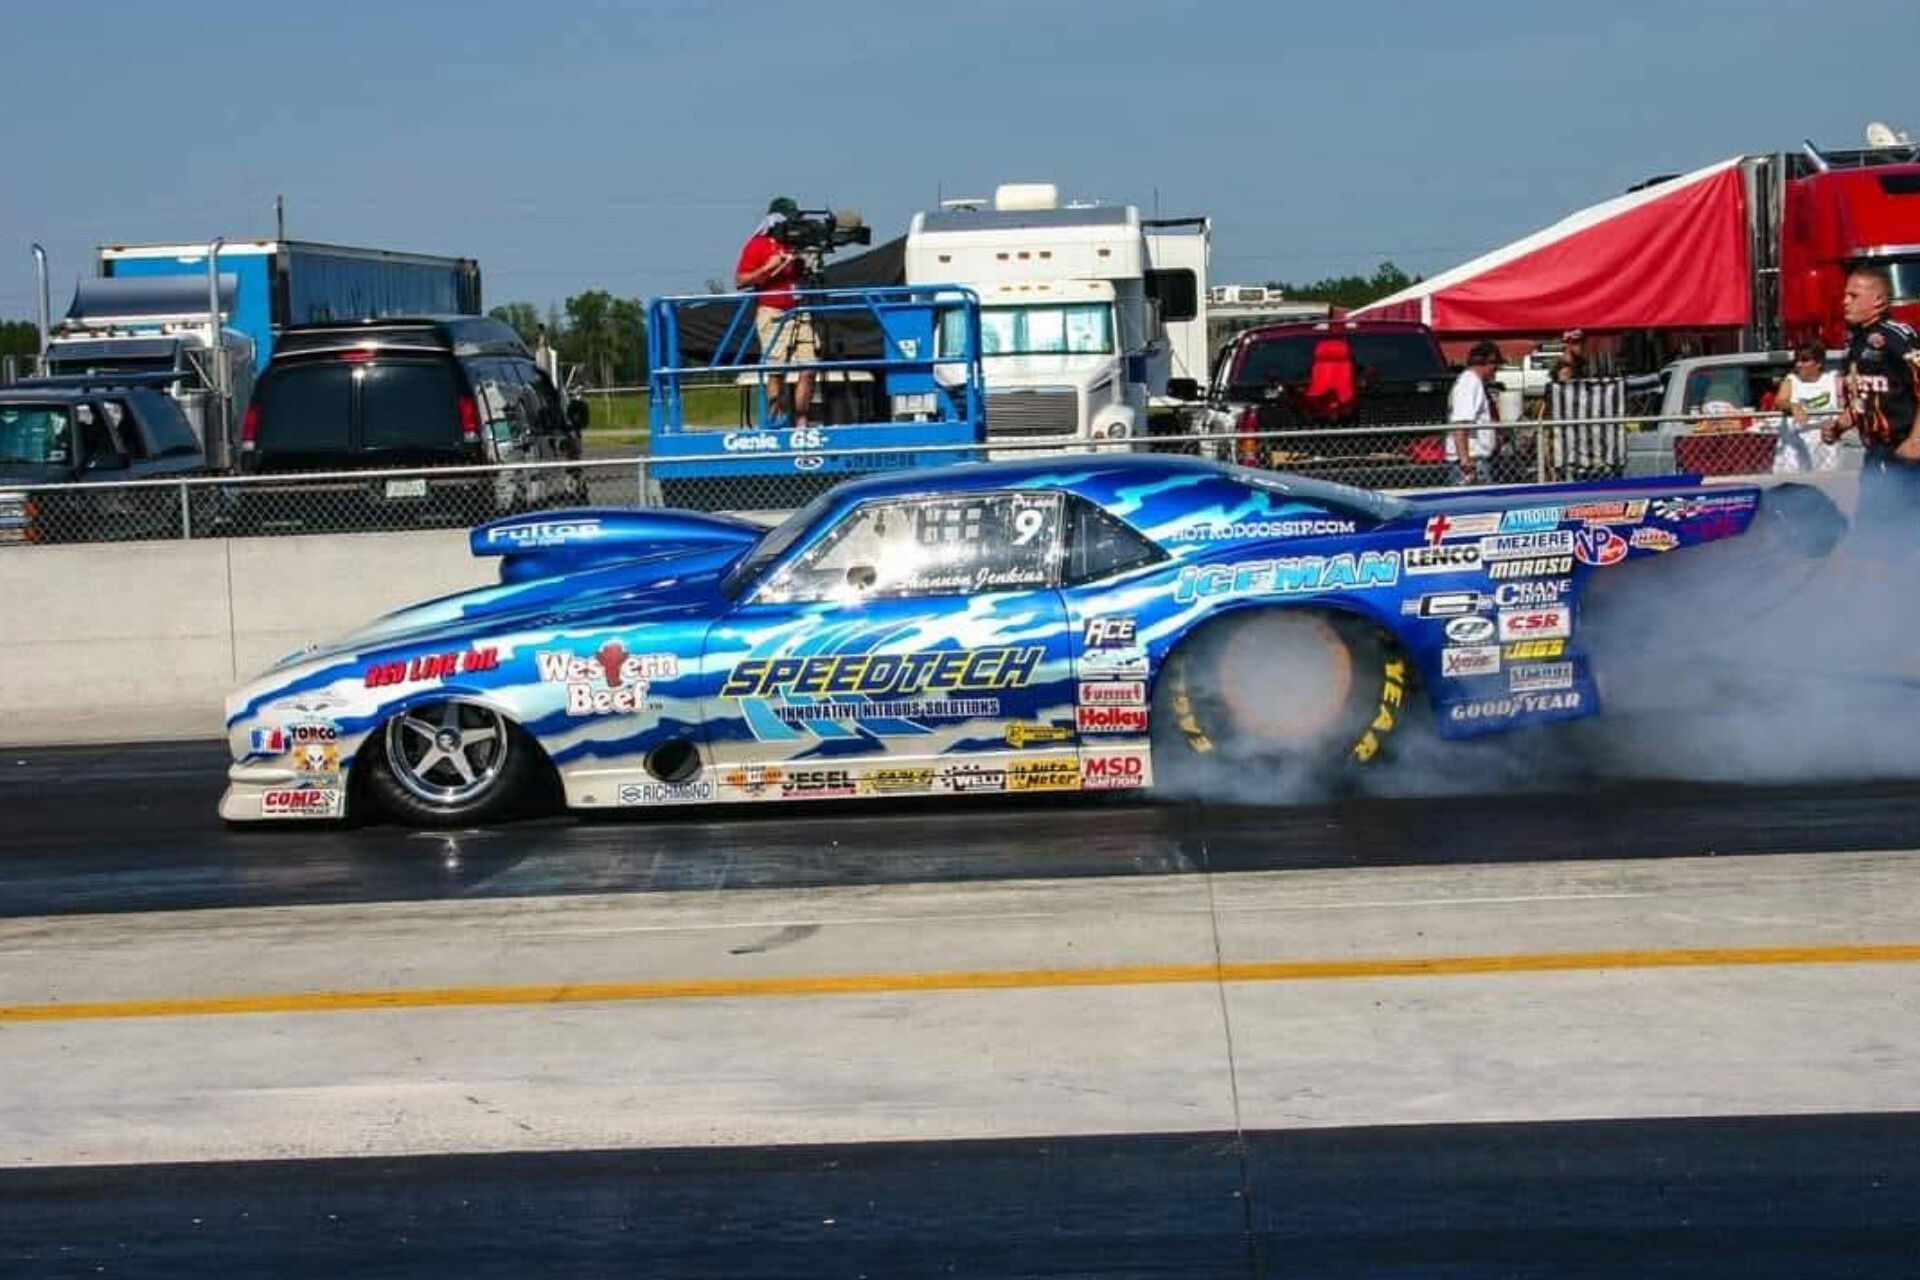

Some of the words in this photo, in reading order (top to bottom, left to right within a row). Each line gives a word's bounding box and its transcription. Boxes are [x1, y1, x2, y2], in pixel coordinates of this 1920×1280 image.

[723, 432, 777, 450] Genie
[1012, 509, 1043, 545] 9
[1497, 533, 1569, 549] MEZIERE
[1576, 527, 1610, 563] VP
[1407, 546, 1479, 568] LENCO
[1174, 550, 1400, 603] ICEMAN
[1489, 557, 1572, 579] MOROSO
[1507, 614, 1560, 629] CSR
[1084, 619, 1136, 646] ACE
[364, 660, 407, 688] RED
[410, 653, 458, 682] LINE
[537, 650, 679, 688] Western
[720, 646, 1045, 698] SPEEDTECH
[566, 679, 647, 716] Beef
[780, 703, 857, 721] INNOVATIVE
[1079, 708, 1147, 729] Holley
[292, 726, 337, 740] TORCO
[1086, 757, 1142, 776] MSD
[782, 771, 856, 791] JESEL
[265, 791, 322, 806] COMP
[642, 783, 711, 801] RICHMOND
